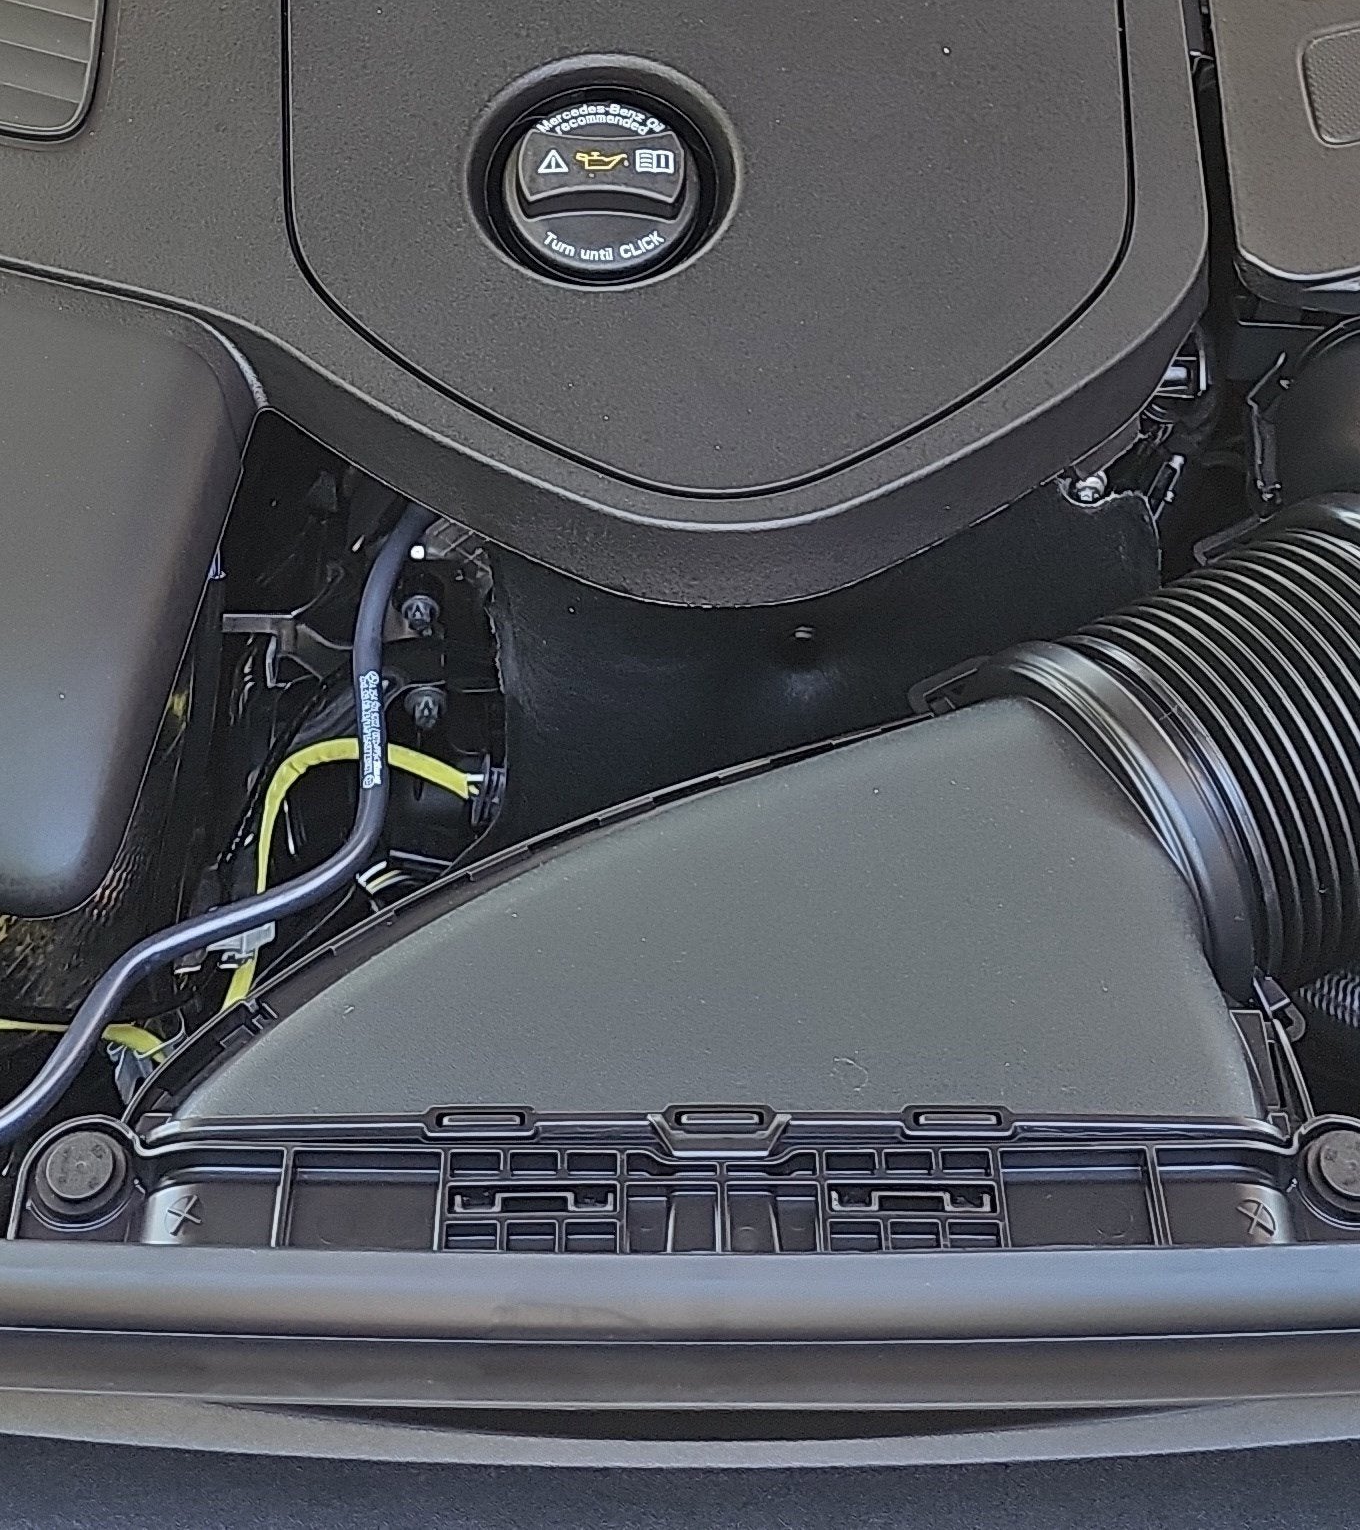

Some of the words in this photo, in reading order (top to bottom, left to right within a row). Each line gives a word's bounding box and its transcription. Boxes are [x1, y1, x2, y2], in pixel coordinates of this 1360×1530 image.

[536, 103, 646, 133] Mercedes-Benz
[554, 114, 651, 136] recommended
[543, 231, 576, 258] Turn
[580, 246, 614, 262] until
[619, 230, 666, 260] CLICK
